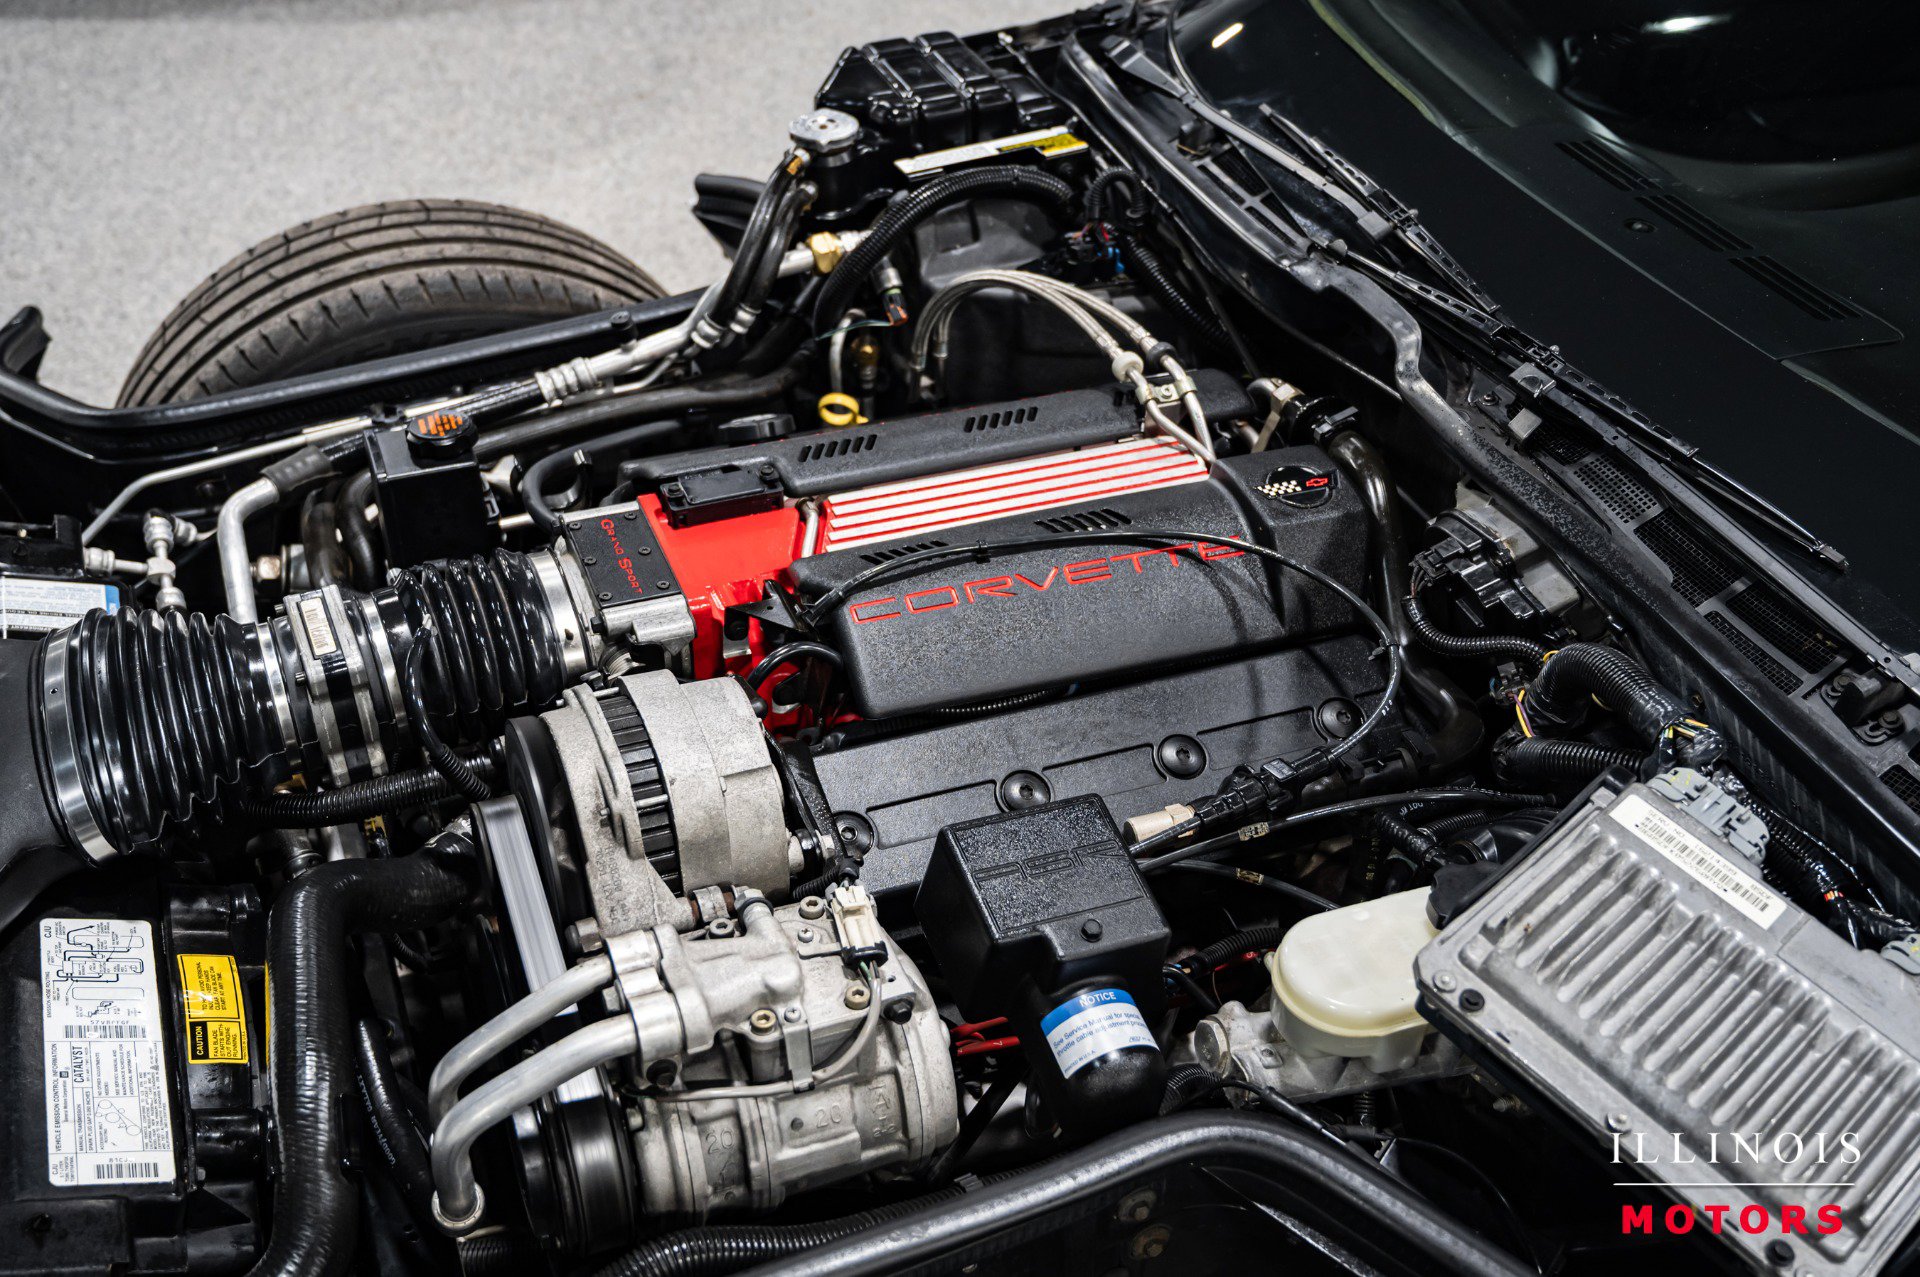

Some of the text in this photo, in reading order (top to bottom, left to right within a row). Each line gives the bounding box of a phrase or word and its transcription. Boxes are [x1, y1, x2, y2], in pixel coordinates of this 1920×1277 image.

[849, 535, 1245, 624] CORVETTE
[44, 926, 52, 938] CJU
[1079, 991, 1117, 1008] NOTICE
[195, 1026, 204, 1055] CAUTION
[1053, 1038, 1064, 1050] See
[1064, 1023, 1088, 1040] Service
[51, 1043, 59, 1077] INFORMATION
[72, 1046, 85, 1083] CATALYST
[52, 1078, 60, 1102] CONTROL
[815, 1103, 844, 1129] 20
[705, 1129, 735, 1155] 20
